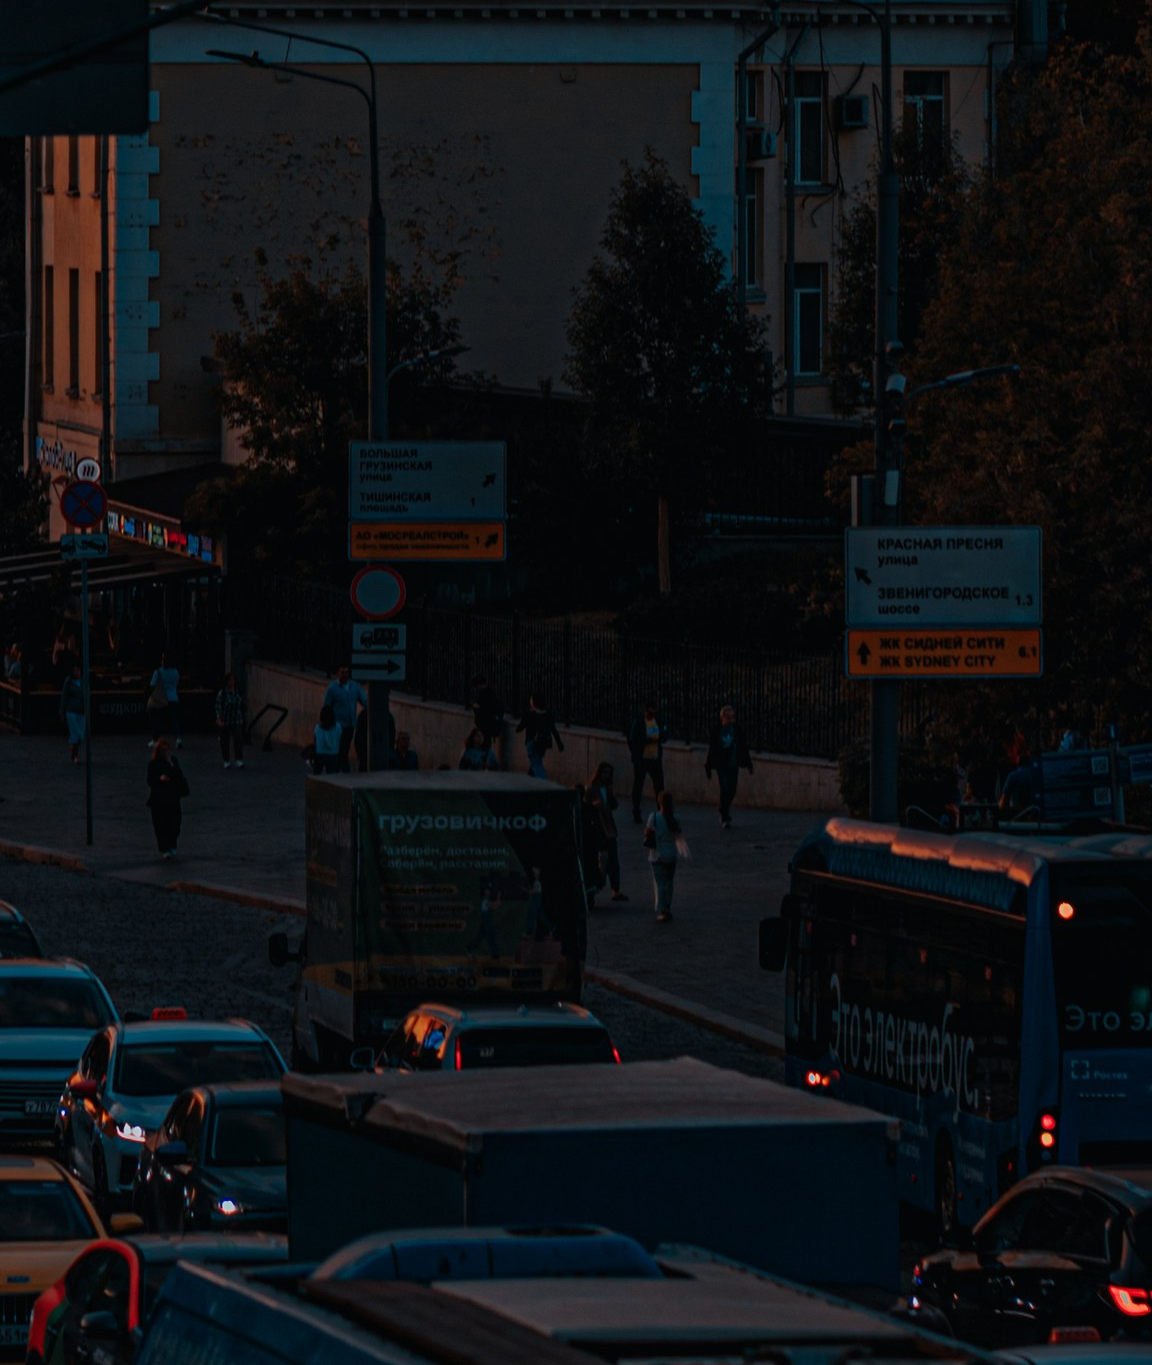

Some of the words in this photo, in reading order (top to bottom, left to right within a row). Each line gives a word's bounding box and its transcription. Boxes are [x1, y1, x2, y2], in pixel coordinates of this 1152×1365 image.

[359, 448, 418, 459] БОЛЬШАЯ
[359, 460, 433, 471] ГРУЗИНСКАЯ
[359, 473, 392, 483] улица
[359, 492, 432, 502] ТИШИНСКАЯ
[359, 504, 409, 514] площадь
[356, 531, 371, 540] АО
[374, 530, 470, 540] «МОСРЕАЛСТРОЙ»
[878, 538, 942, 550] КРАСНАЯ
[946, 538, 1003, 550] ПРЕСНЯ
[878, 555, 918, 568] улица
[878, 587, 1009, 601] ЗВЕНИГОРОДСКОЕ
[1015, 594, 1034, 606] 1.3
[878, 605, 920, 614] шоссе
[880, 637, 900, 648] ЖК
[904, 636, 962, 651] СИДНЕЙ
[966, 637, 1005, 649] СИТИ
[1018, 646, 1037, 658] 6.1
[880, 656, 900, 667] ЖК
[905, 656, 961, 667] SYDNEY
[965, 656, 996, 667] CITY
[99, 701, 146, 717] ФУДКОР
[378, 812, 548, 834] грузовичкоф
[1064, 1004, 1121, 1032] Это
[829, 972, 862, 1067] Это
[864, 1001, 980, 1125] электробус.
